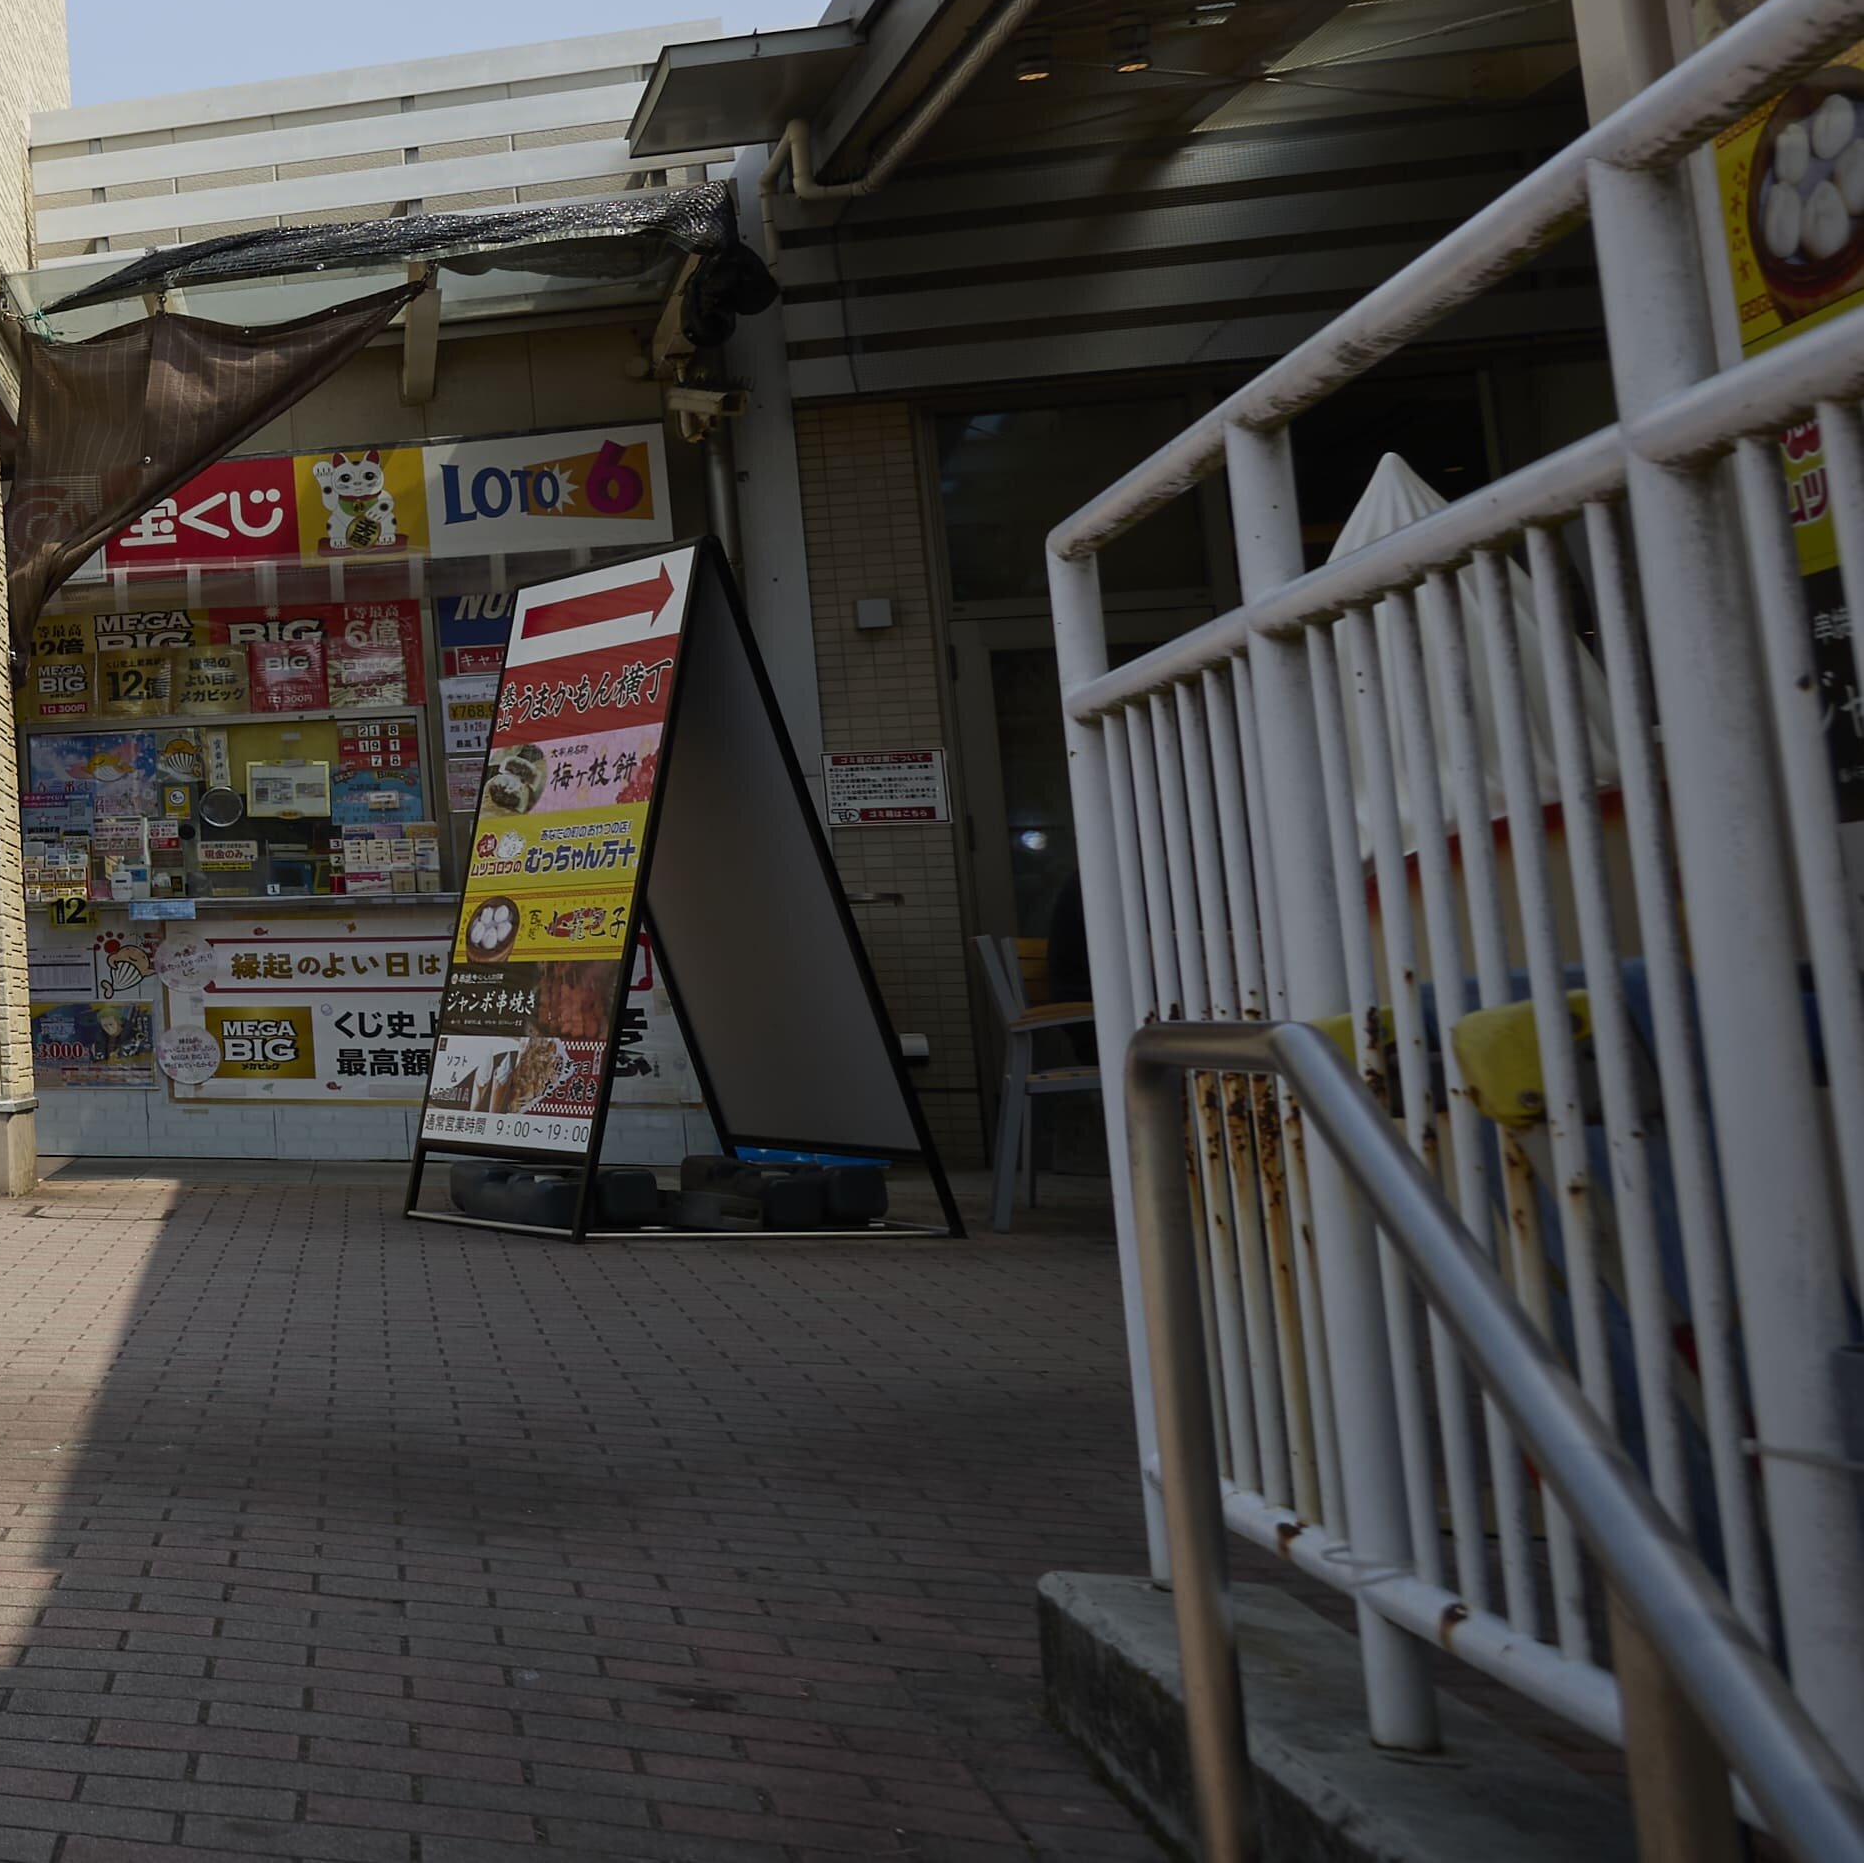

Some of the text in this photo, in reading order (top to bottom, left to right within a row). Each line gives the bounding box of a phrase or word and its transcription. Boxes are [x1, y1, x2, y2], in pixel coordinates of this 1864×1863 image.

[454, 595, 513, 621] NU
[94, 609, 194, 633] MEGA
[37, 664, 87, 677] MEGA
[265, 656, 310, 671] BIG
[37, 676, 88, 694] BIG
[518, 658, 673, 724] うまかもん横丁
[525, 838, 636, 874] むっちゃん万十
[471, 860, 522, 877] ムツゴロウの
[231, 951, 442, 979] 縁起のよい日は
[447, 989, 537, 1015] ジャンボ串焼き
[222, 1019, 296, 1038] MEGA
[222, 1037, 301, 1062] BIG
[446, 1054, 468, 1067] ソフト
[425, 1114, 487, 1135] 通常営業時間
